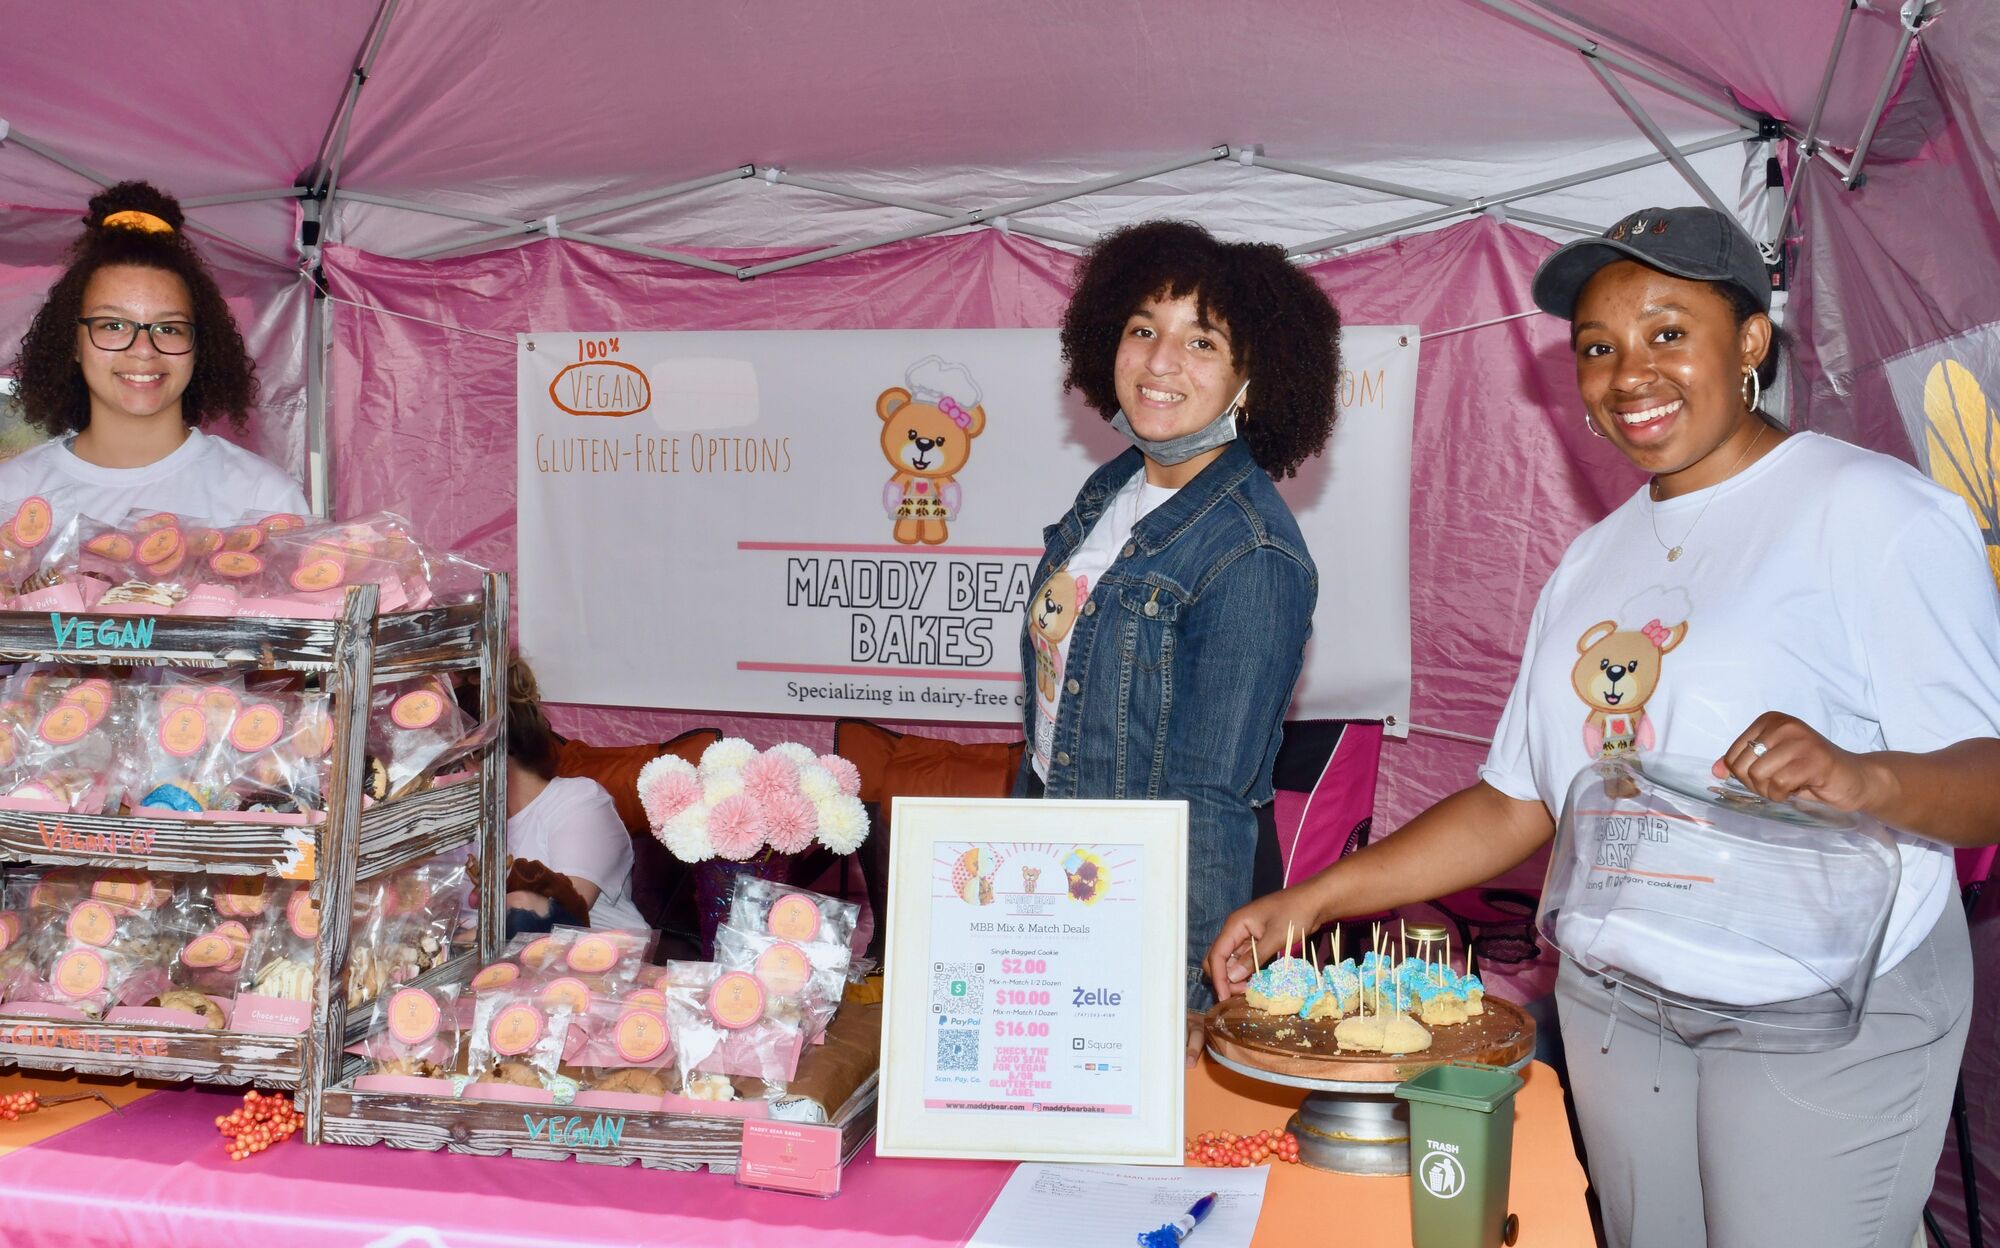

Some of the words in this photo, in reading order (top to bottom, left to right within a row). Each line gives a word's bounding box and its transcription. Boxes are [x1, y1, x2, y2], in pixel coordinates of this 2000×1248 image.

[578, 337, 621, 362] 100%
[569, 370, 643, 410] VEGAN
[1341, 368, 1384, 409] OM
[536, 433, 680, 473] GLUTEN-FREE
[691, 433, 792, 474] OPTIONS
[787, 558, 937, 610] MADDY
[948, 562, 1032, 613] BEA
[50, 611, 158, 651] VEGAN
[850, 614, 994, 667] BAKES
[787, 681, 893, 706] Specializing
[898, 684, 917, 704] in
[920, 684, 1009, 709] dairy-free
[1647, 880, 1693, 891] cookies!
[969, 922, 994, 932] MBB
[997, 923, 1015, 933] Mix
[1018, 923, 1025, 933] &
[1028, 923, 1060, 933] Match
[1063, 924, 1090, 934] Deals
[1001, 958, 1047, 974] $2.00
[995, 989, 1050, 1005] $10.00
[1072, 986, 1122, 1008] Zelle
[951, 1017, 981, 1026] PayPal
[995, 1020, 1049, 1037] $16.00
[1087, 1039, 1122, 1051] Square
[945, 1102, 1025, 1111] www.maddybear.com
[1042, 1104, 1105, 1113] maddybearbakes
[523, 1113, 626, 1148] VEGAN
[1426, 1139, 1460, 1154] TRASH
